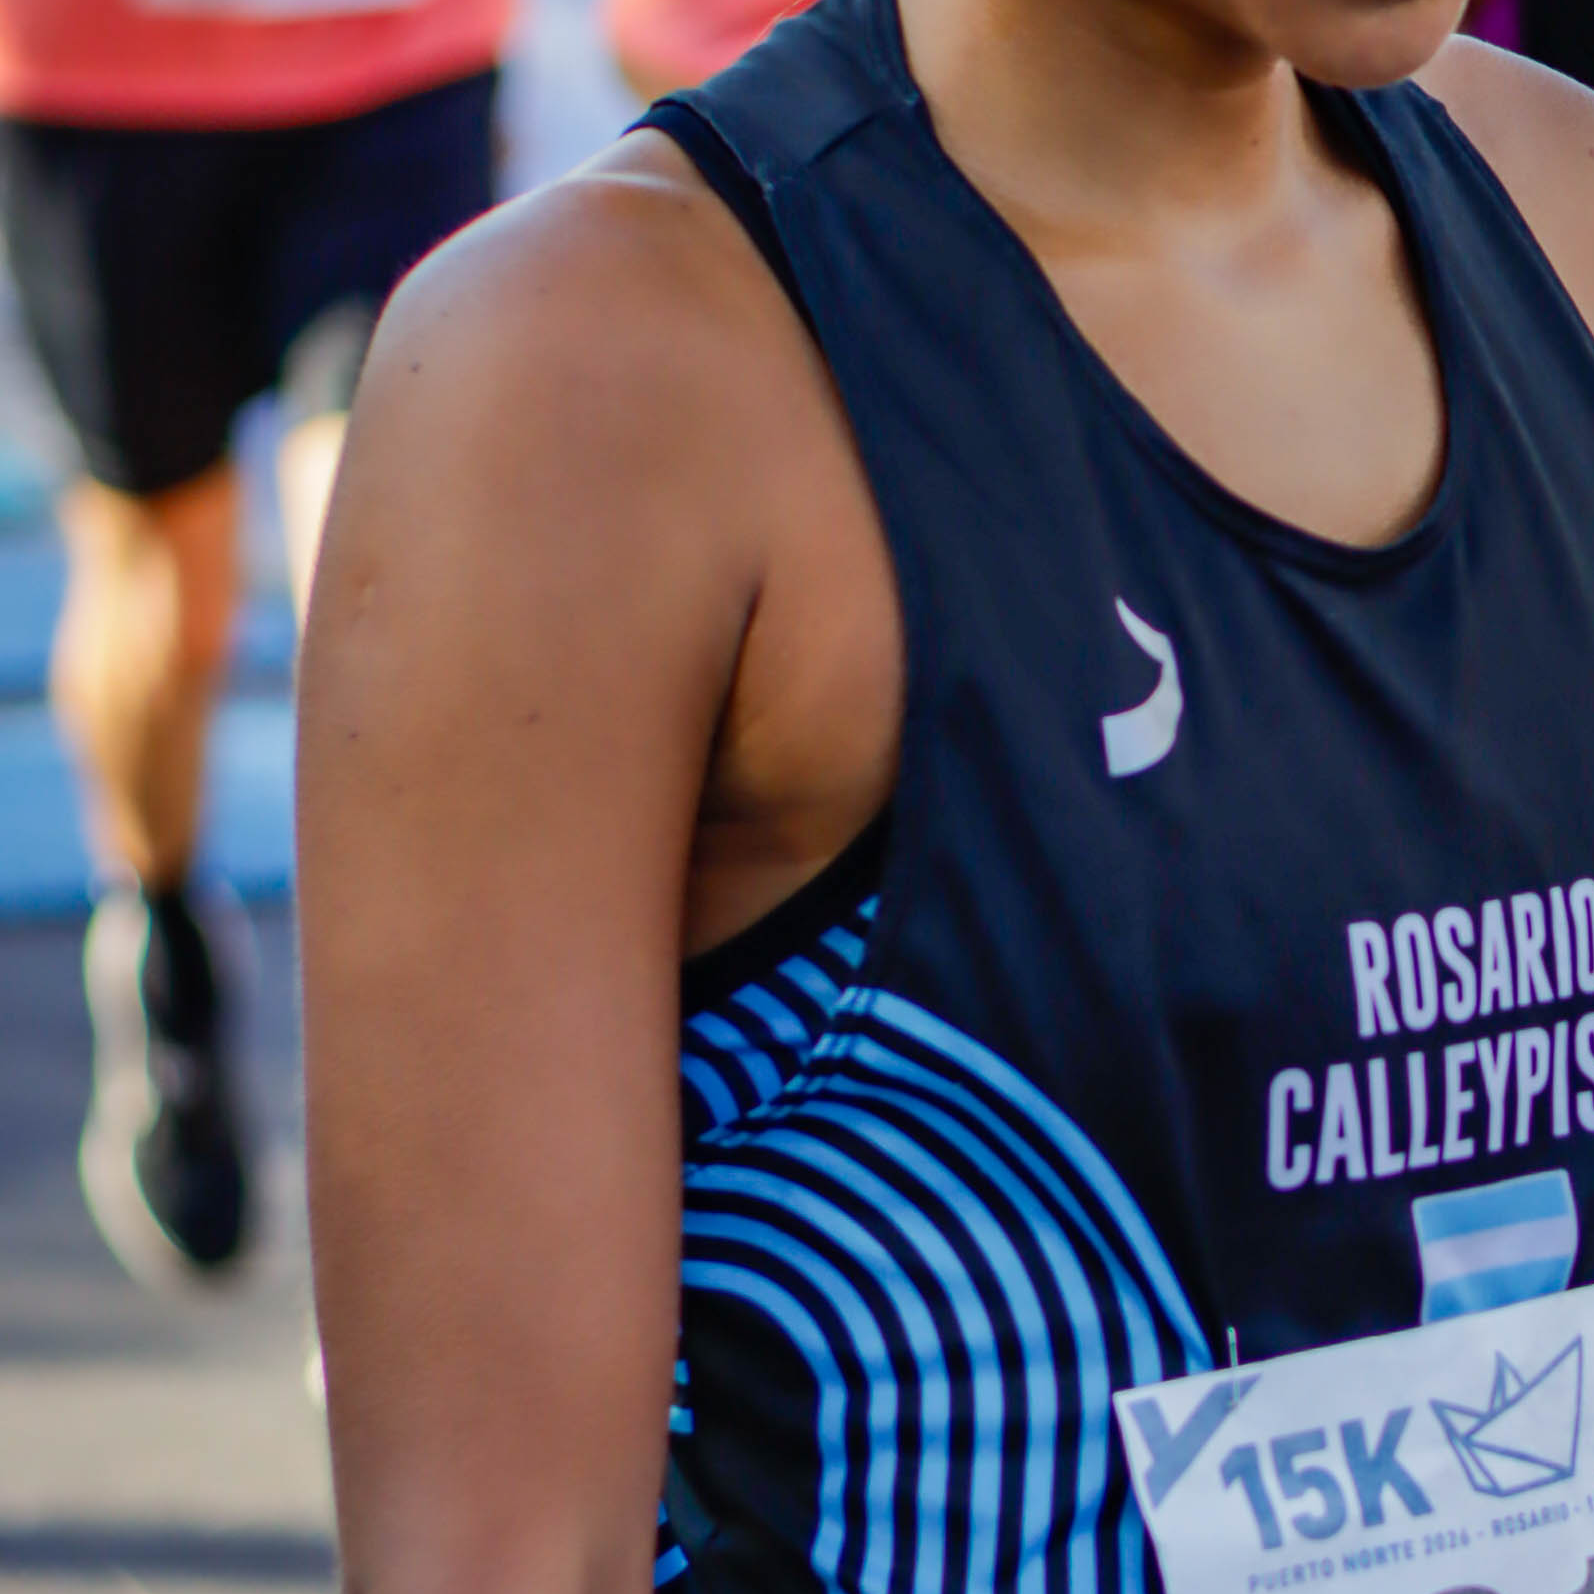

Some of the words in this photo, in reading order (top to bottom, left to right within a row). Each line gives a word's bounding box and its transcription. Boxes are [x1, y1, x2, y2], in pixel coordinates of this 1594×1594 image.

[1219, 1406, 1434, 1551] 15K
[1248, 1556, 1335, 1593] PUERTO
[1342, 1539, 1415, 1573] NORTE
[1423, 1527, 1471, 1556] 2026
[1491, 1501, 1570, 1538] ROSARIO
